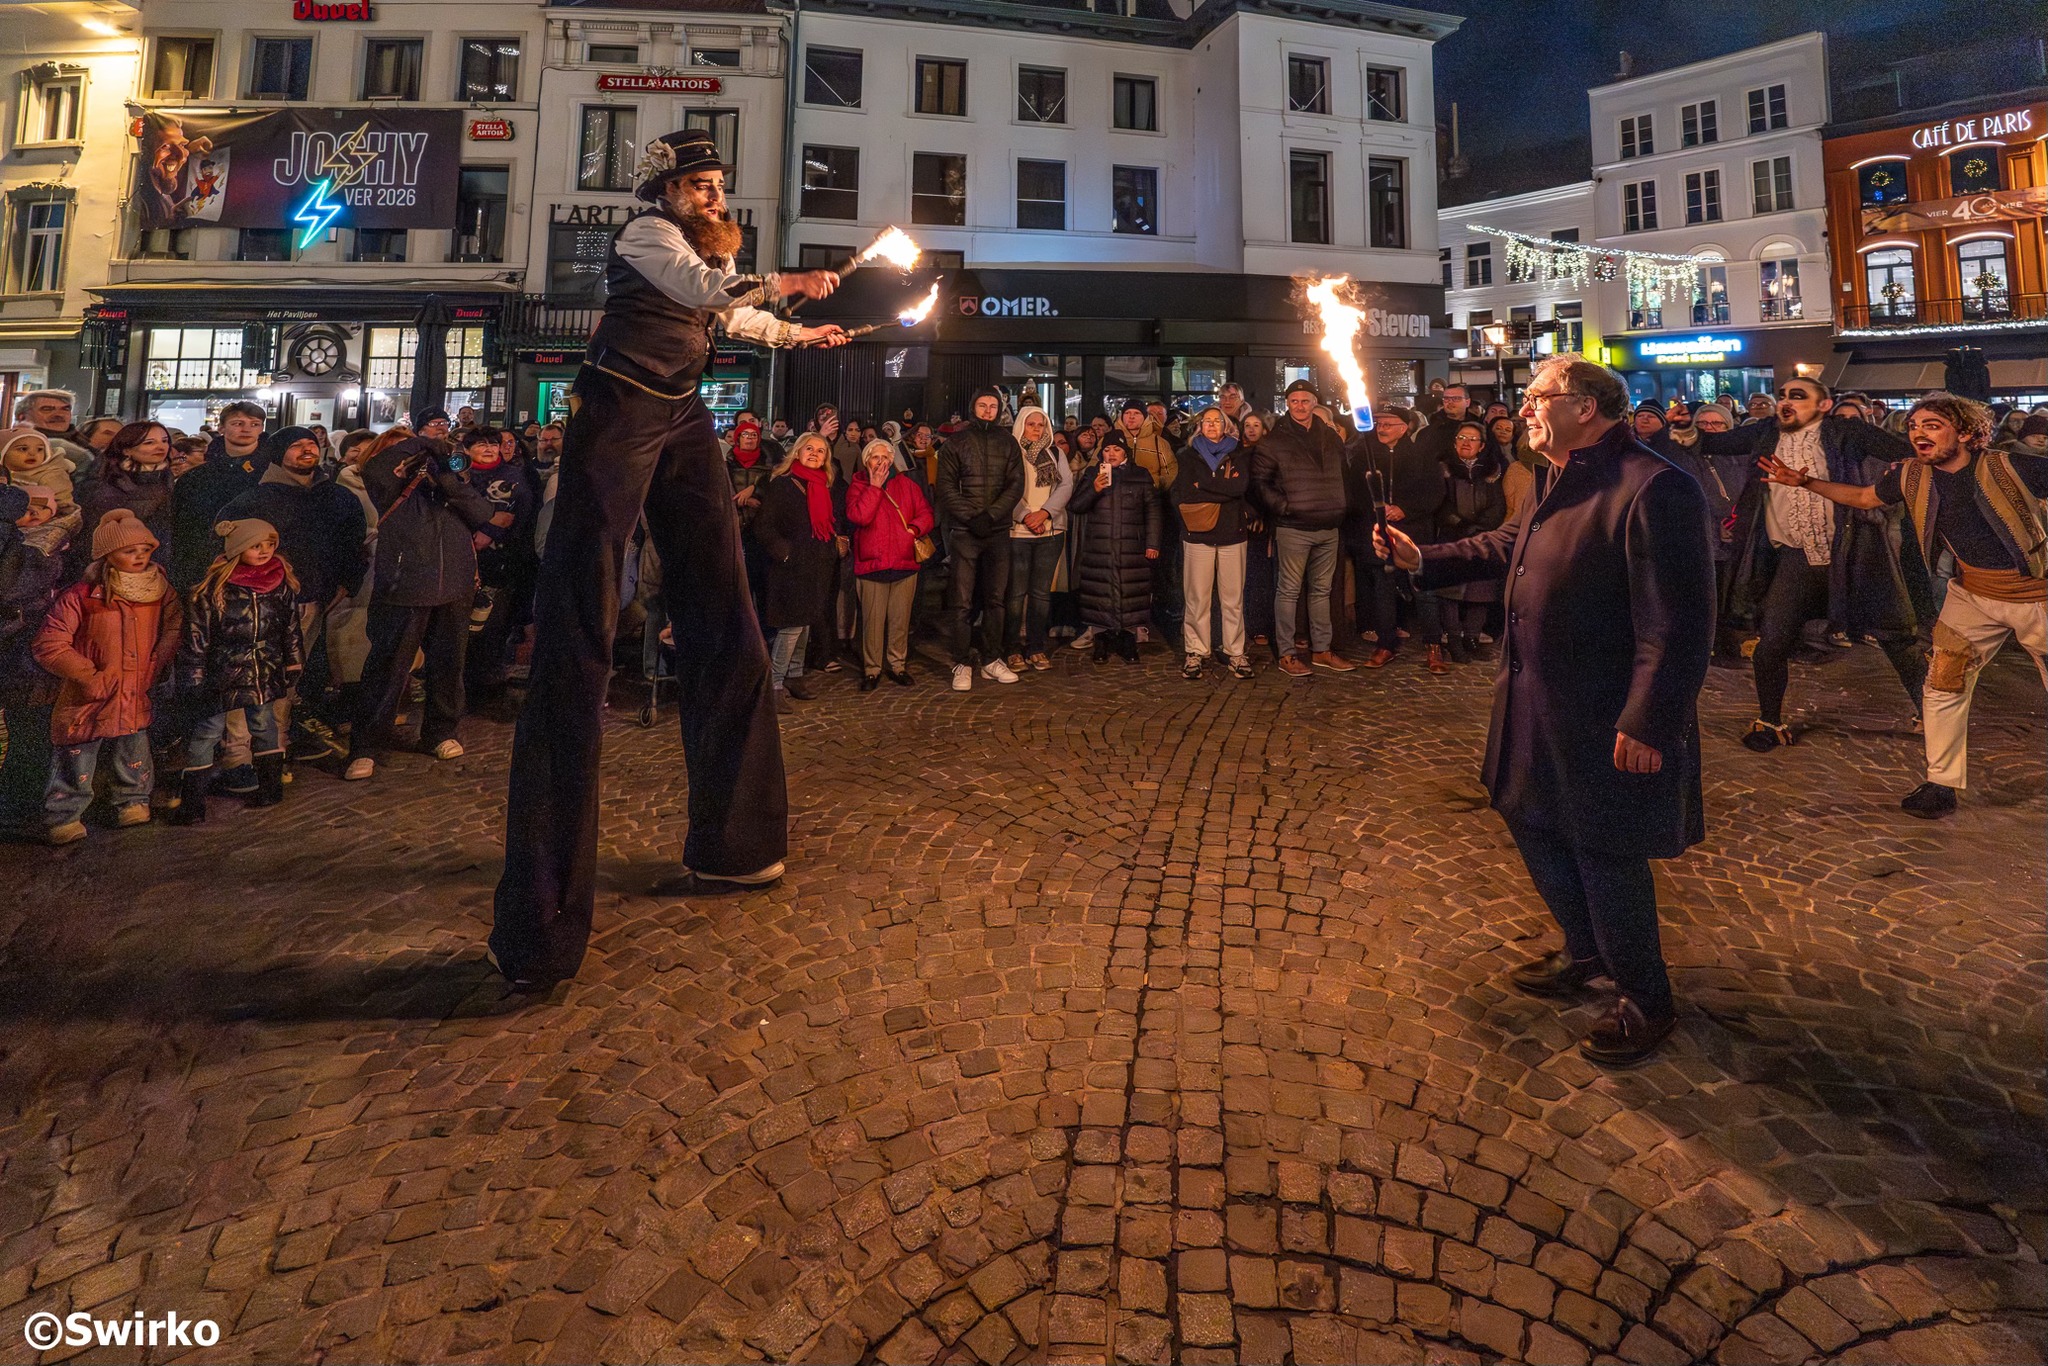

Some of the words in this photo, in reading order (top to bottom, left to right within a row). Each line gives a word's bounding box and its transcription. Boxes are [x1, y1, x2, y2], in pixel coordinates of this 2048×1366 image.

[294, 0, 370, 20] Duvel
[607, 77, 656, 88] STELLA
[661, 79, 711, 89] ARTOIS
[1912, 121, 1952, 149] CAFÉ
[1955, 120, 1978, 143] DE
[1983, 109, 2031, 138] PARIS
[273, 131, 429, 186] JOSHY
[377, 188, 416, 206] 2026
[1926, 209, 1949, 218] VIER
[97, 308, 127, 318] Duvel
[266, 310, 281, 318] Het
[283, 310, 318, 320] Paviljoen
[455, 308, 483, 318] Duvel
[1367, 307, 1430, 337] Steven
[535, 353, 563, 364] Duvel
